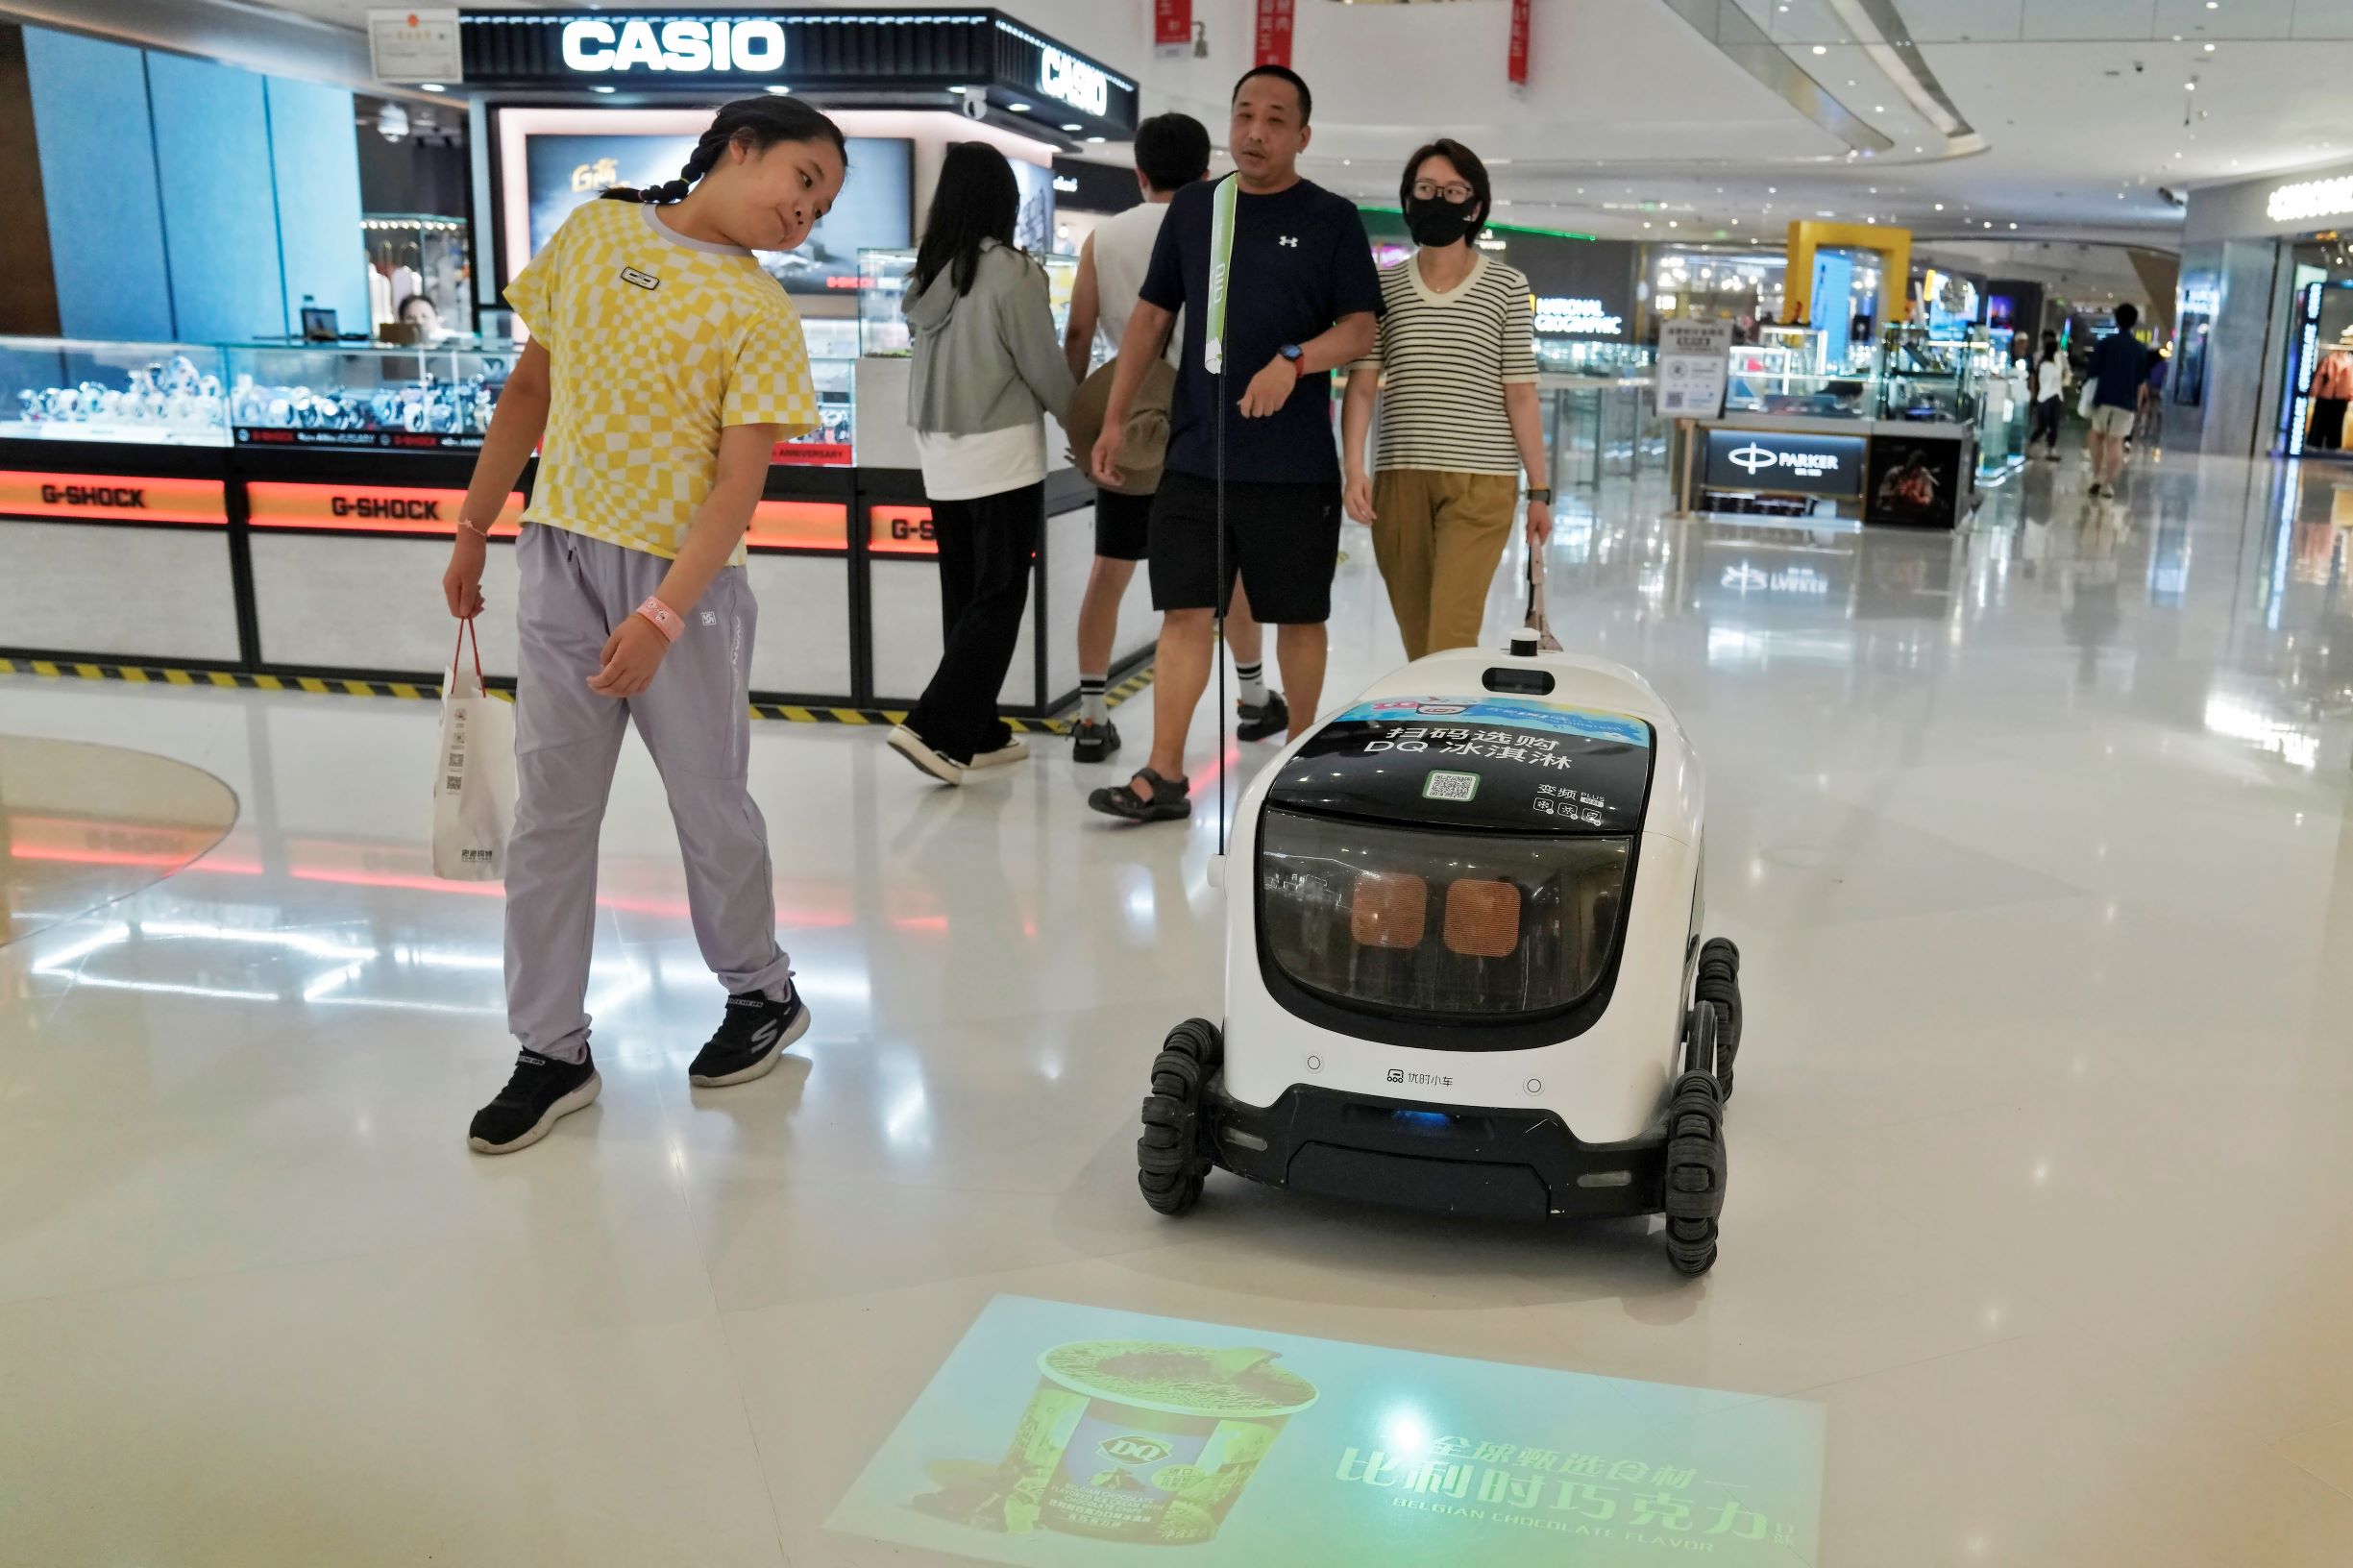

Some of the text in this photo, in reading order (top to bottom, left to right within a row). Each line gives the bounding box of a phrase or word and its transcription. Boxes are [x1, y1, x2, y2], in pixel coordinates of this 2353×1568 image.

[562, 20, 785, 71] CASIO
[1042, 46, 1107, 116] CASIO
[779, 449, 844, 459] ANNIVERSARY
[1779, 452, 1839, 470] PARKER
[41, 484, 149, 508] G-SHOCK
[331, 497, 441, 521] G-SHOCK
[1385, 726, 1559, 752] 扫码选购
[1363, 740, 1573, 770] DQ 冰淇淋
[1537, 783, 1577, 800] 变频
[1109, 1439, 1161, 1461] DQ
[1432, 1434, 1699, 1489] 全球甄选食材
[1334, 1446, 1770, 1540] 比利时巧克力
[1391, 1496, 1714, 1554] BELGIAN CHOCOLATE FLAVOR
